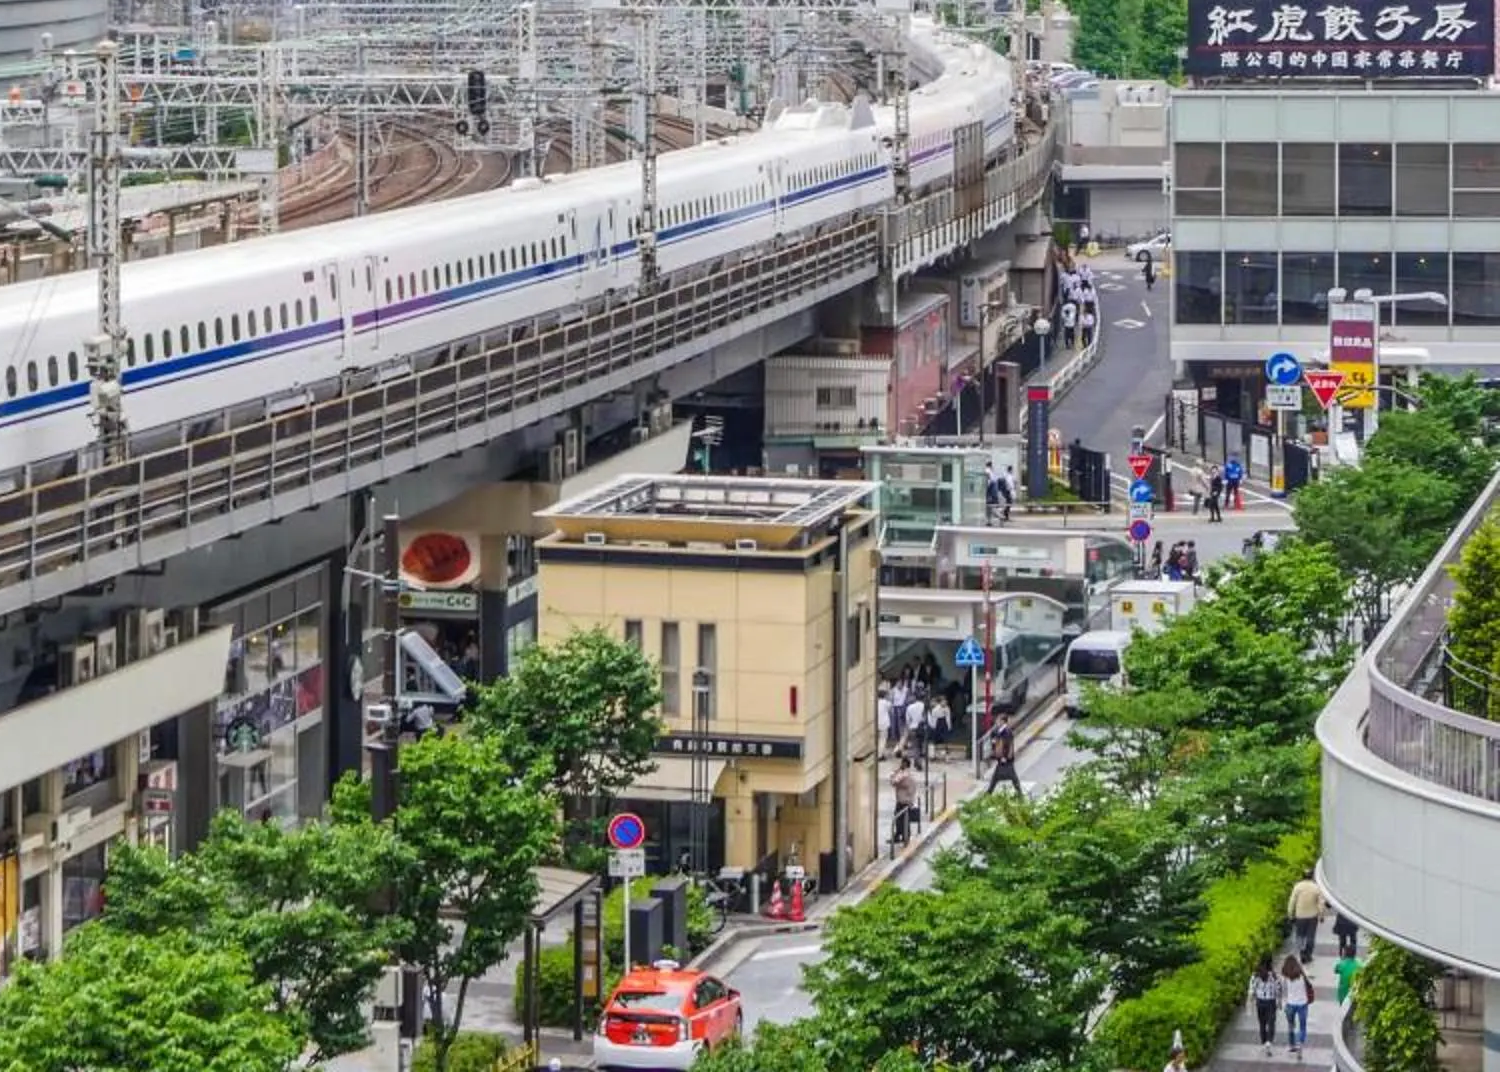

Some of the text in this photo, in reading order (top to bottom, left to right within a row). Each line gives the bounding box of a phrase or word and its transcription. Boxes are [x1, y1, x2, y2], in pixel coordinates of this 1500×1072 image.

[1207, 2, 1477, 46] 紅虎餃子房
